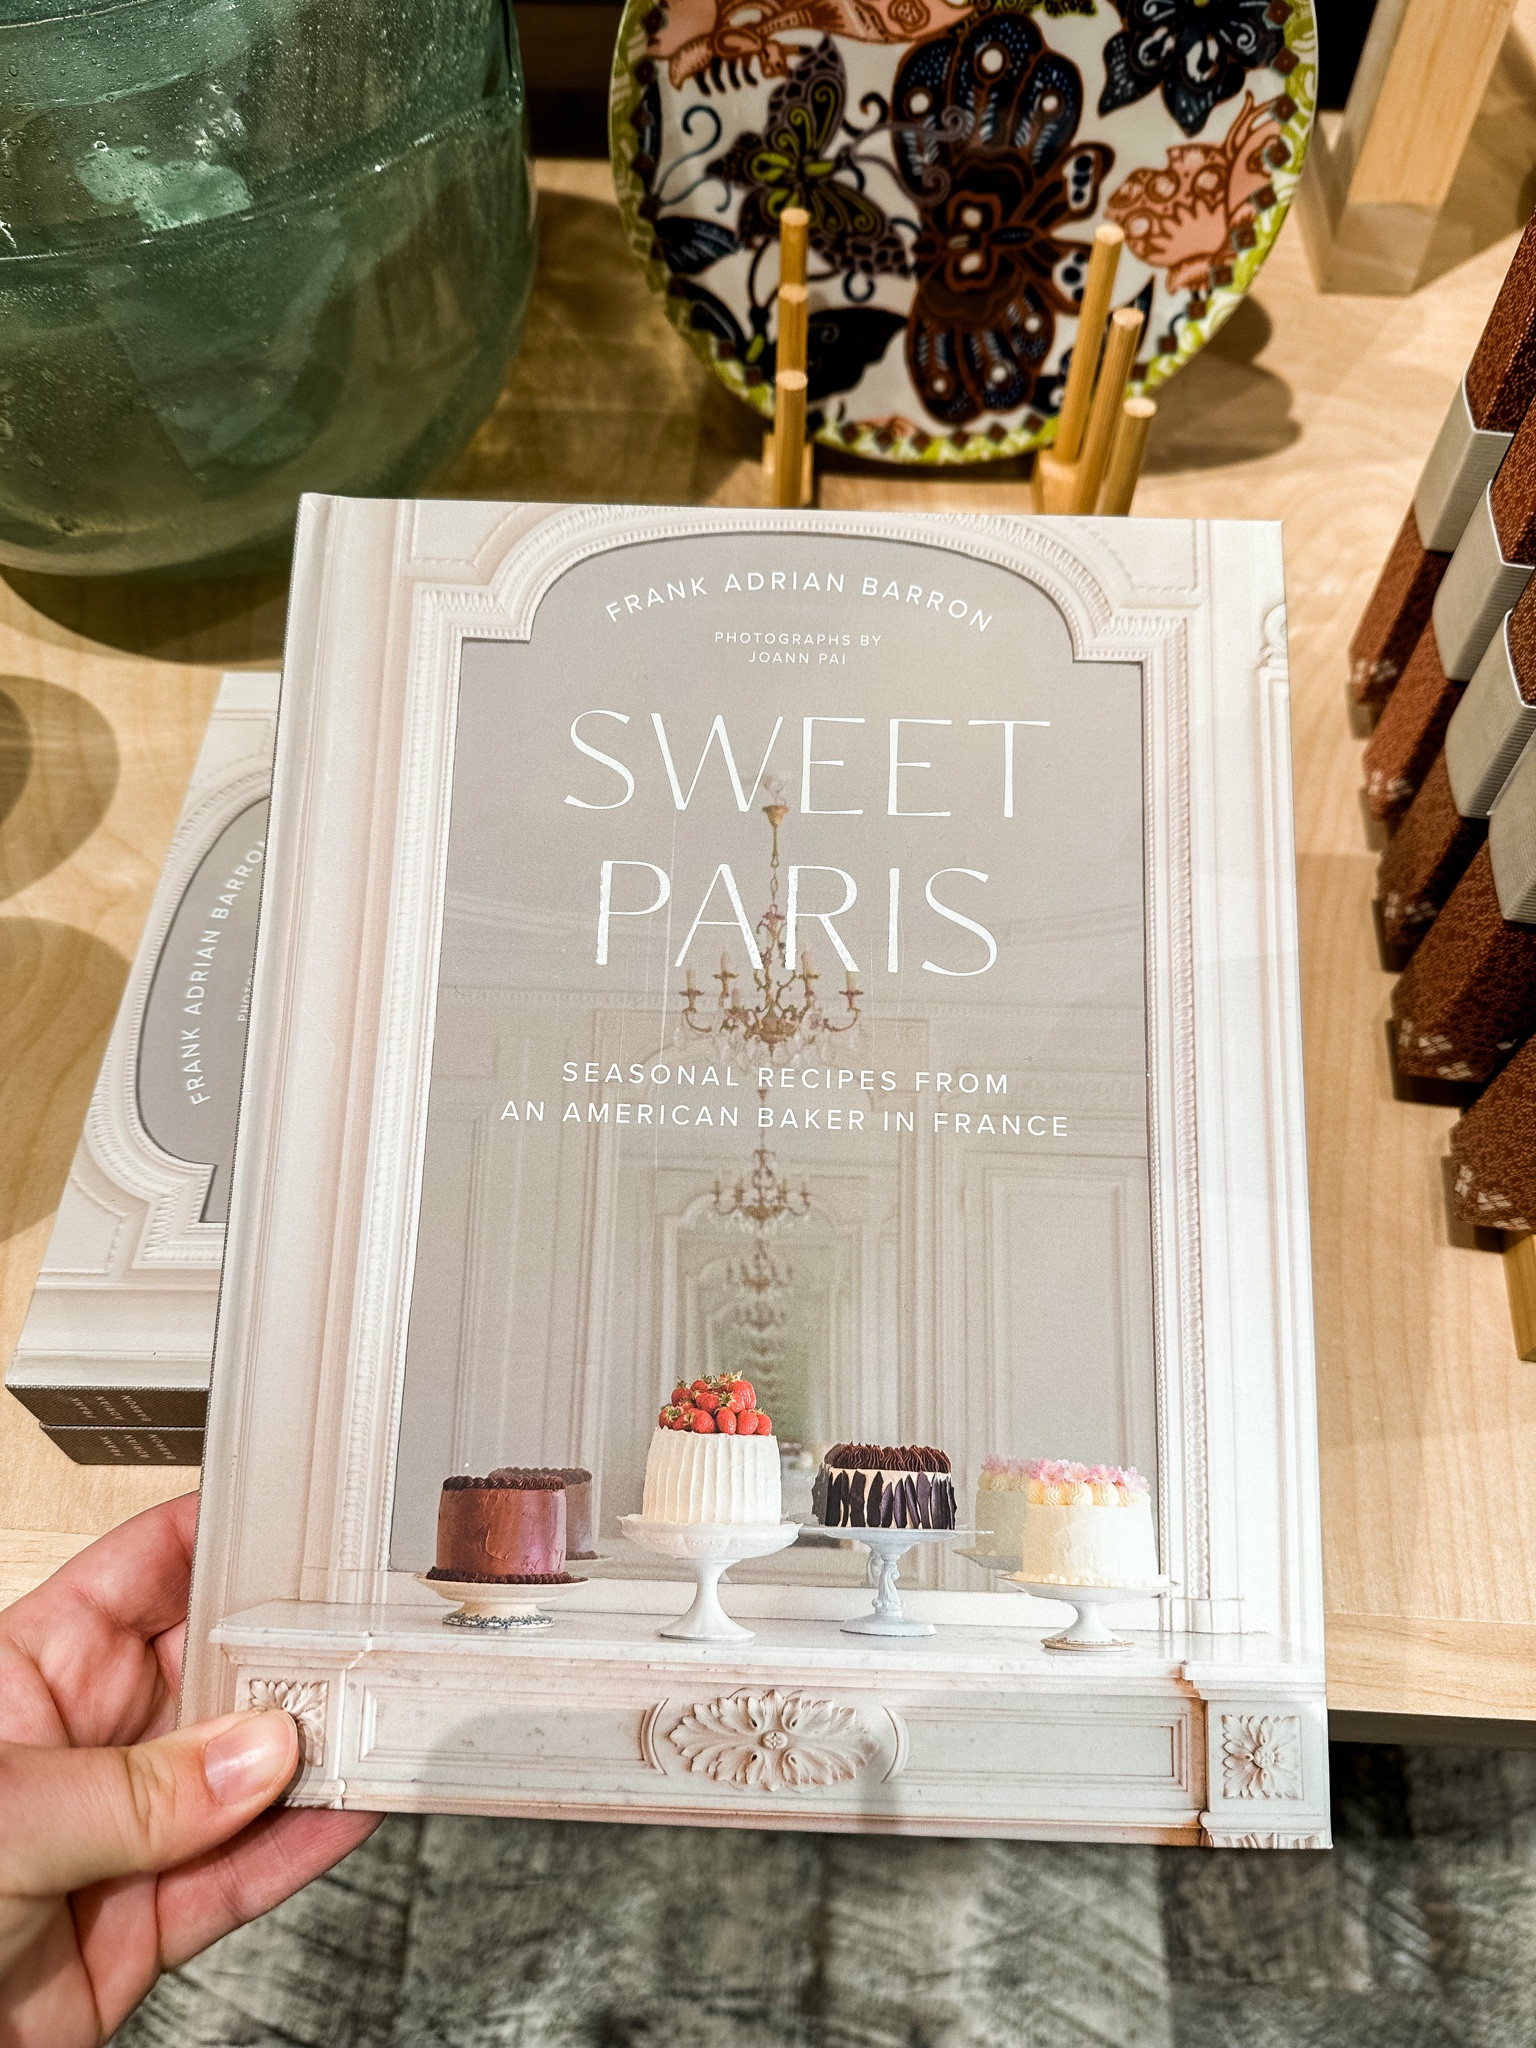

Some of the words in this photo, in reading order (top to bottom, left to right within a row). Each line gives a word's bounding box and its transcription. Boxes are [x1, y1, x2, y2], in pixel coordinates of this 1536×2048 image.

[605, 576, 708, 623] FRANK
[723, 571, 845, 593] ADRIAN
[861, 576, 993, 633] BARRON
[714, 632, 851, 647] PHOTOGRAPHS
[859, 635, 882, 648] BY
[748, 652, 810, 665] JOANN
[818, 653, 847, 666] PAI
[563, 709, 1051, 819] SWEET
[595, 860, 999, 978] PARIS
[184, 929, 221, 1016] ADRIAN
[181, 1027, 211, 1106] FRANK
[562, 1061, 740, 1088] SEASONAL
[757, 1067, 898, 1092] RECIPES
[915, 1071, 1009, 1095] FROM
[500, 1100, 545, 1122] AN
[562, 1103, 740, 1128] AMERICAN
[757, 1107, 865, 1131] BAKER
[883, 1112, 915, 1133] IN
[933, 1113, 1069, 1138] FRANCE
